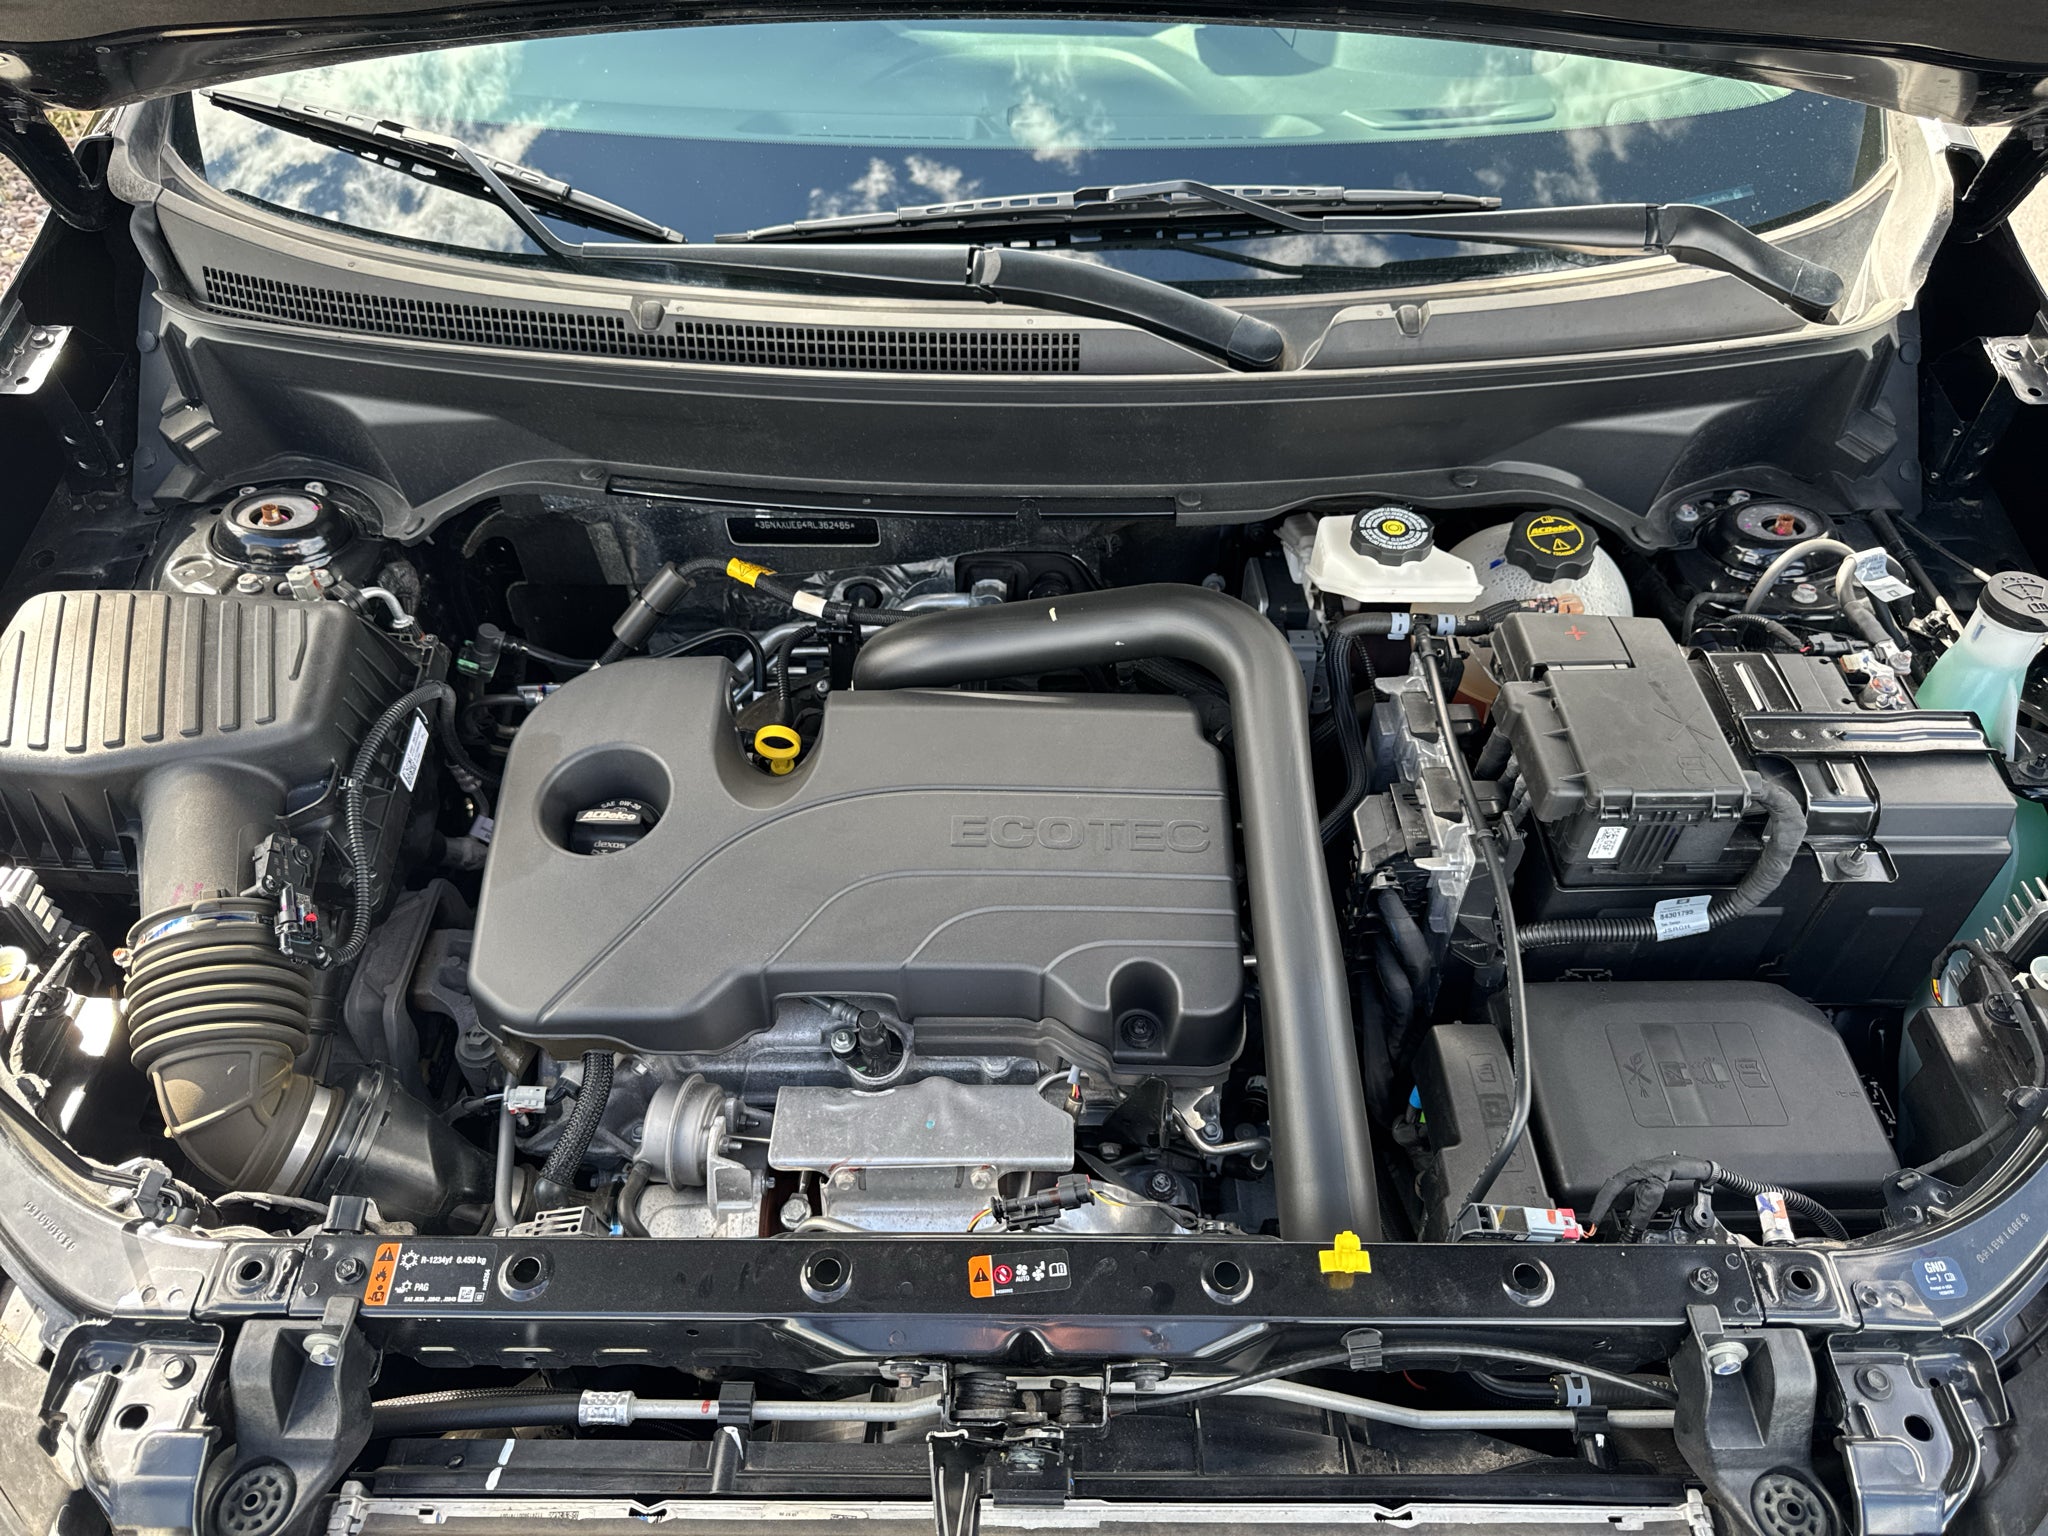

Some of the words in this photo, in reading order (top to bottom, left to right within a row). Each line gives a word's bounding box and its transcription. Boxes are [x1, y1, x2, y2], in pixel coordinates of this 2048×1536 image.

[1530, 525, 1576, 535] ACDelco
[600, 800, 616, 809] SAE
[619, 800, 642, 810] 0W-20
[582, 810, 637, 820] ACDelco
[950, 815, 1211, 854] ECOTEC
[593, 840, 627, 849] dexos
[420, 1255, 453, 1266] R-1234yf
[456, 1256, 476, 1265] 0.450
[476, 1256, 487, 1266] kg
[1924, 1260, 1947, 1274] GND
[413, 1282, 430, 1292] PAG
